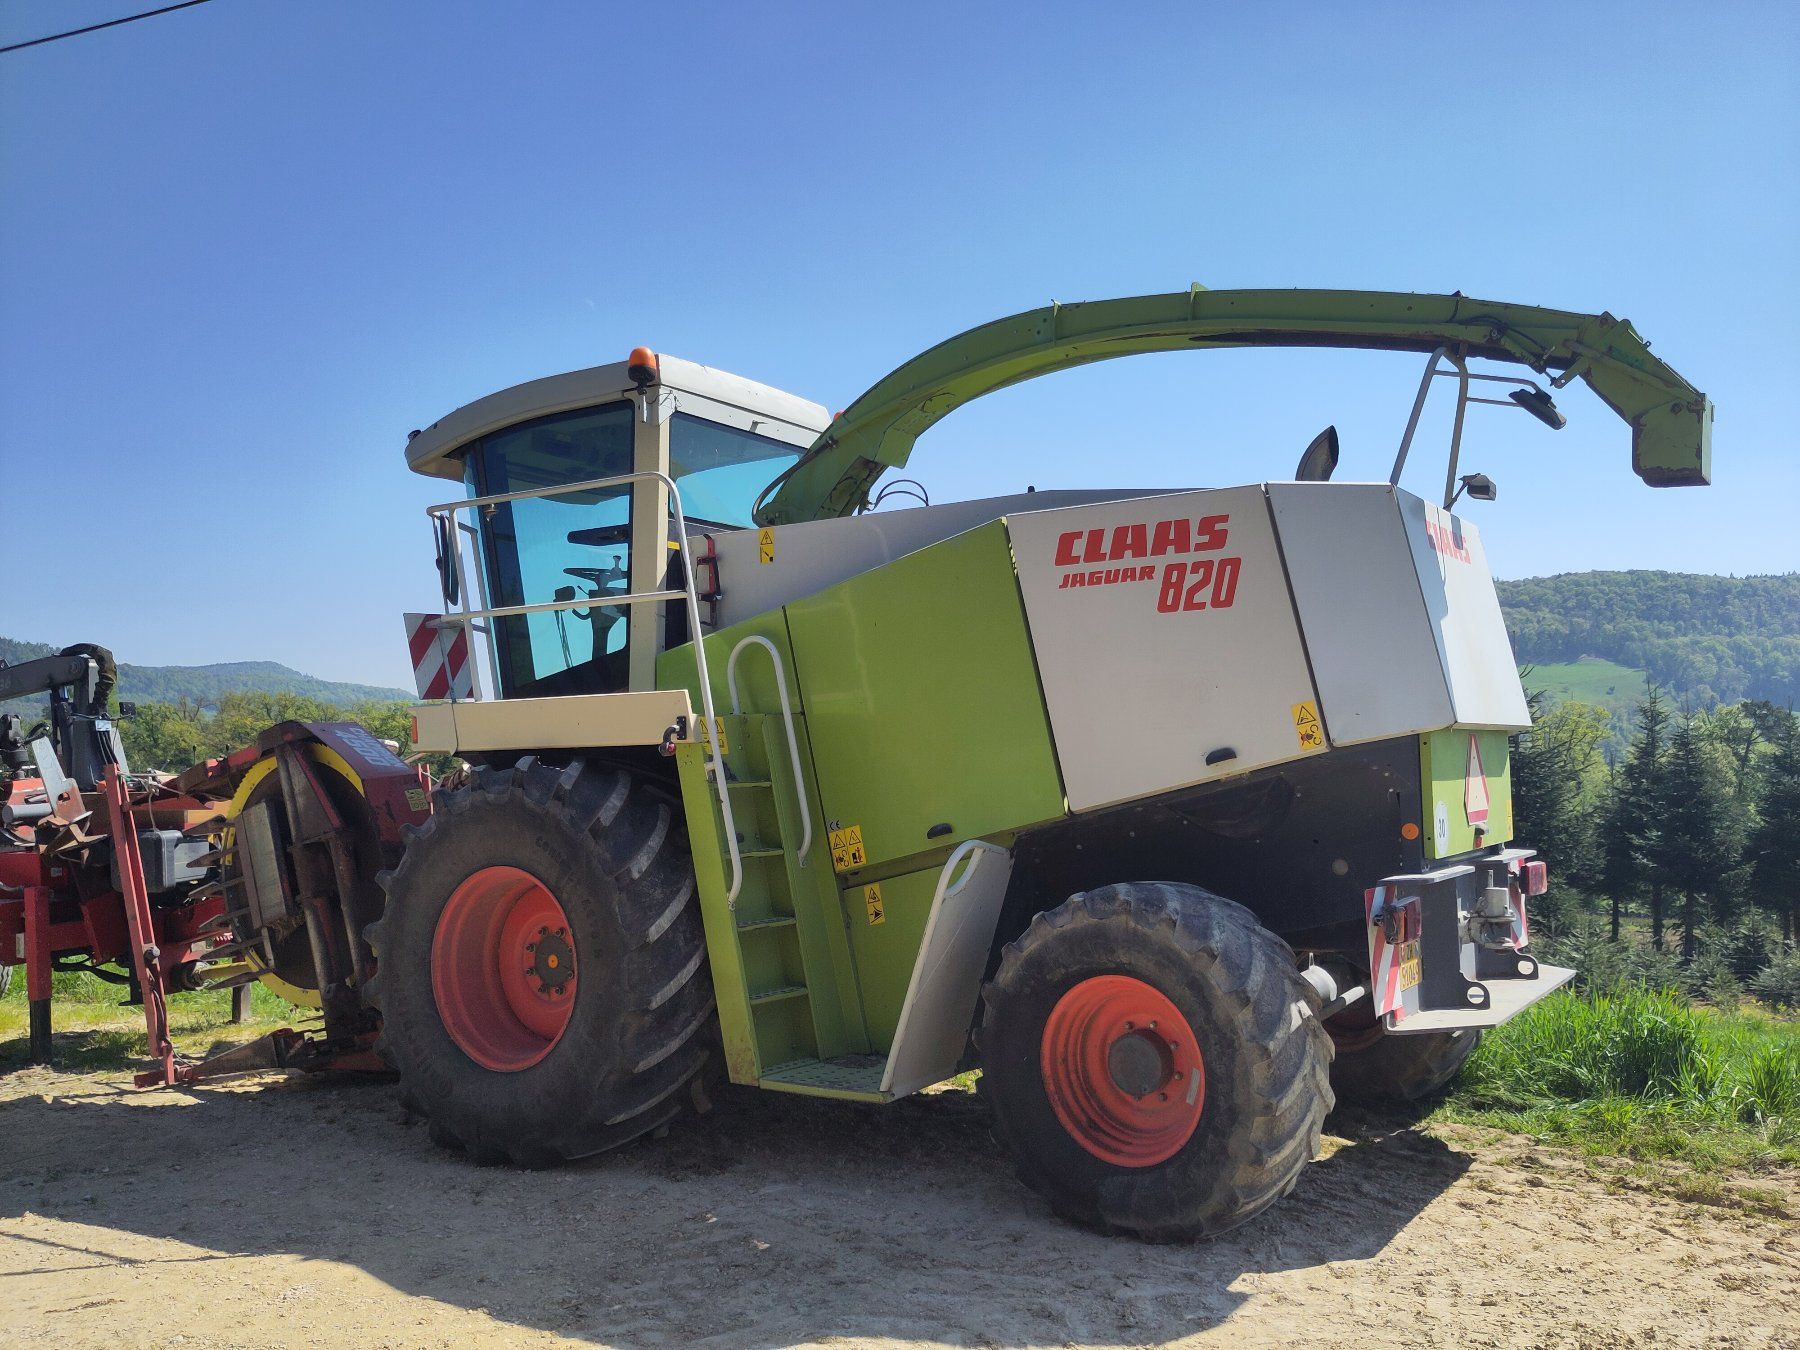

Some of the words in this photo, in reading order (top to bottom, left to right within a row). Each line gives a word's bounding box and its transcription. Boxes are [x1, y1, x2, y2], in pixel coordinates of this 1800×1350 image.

[1055, 514, 1230, 566] CLAAS
[1059, 565, 1156, 589] JAGUAR
[1157, 557, 1242, 614] 820
[1438, 818, 1446, 838] 30
